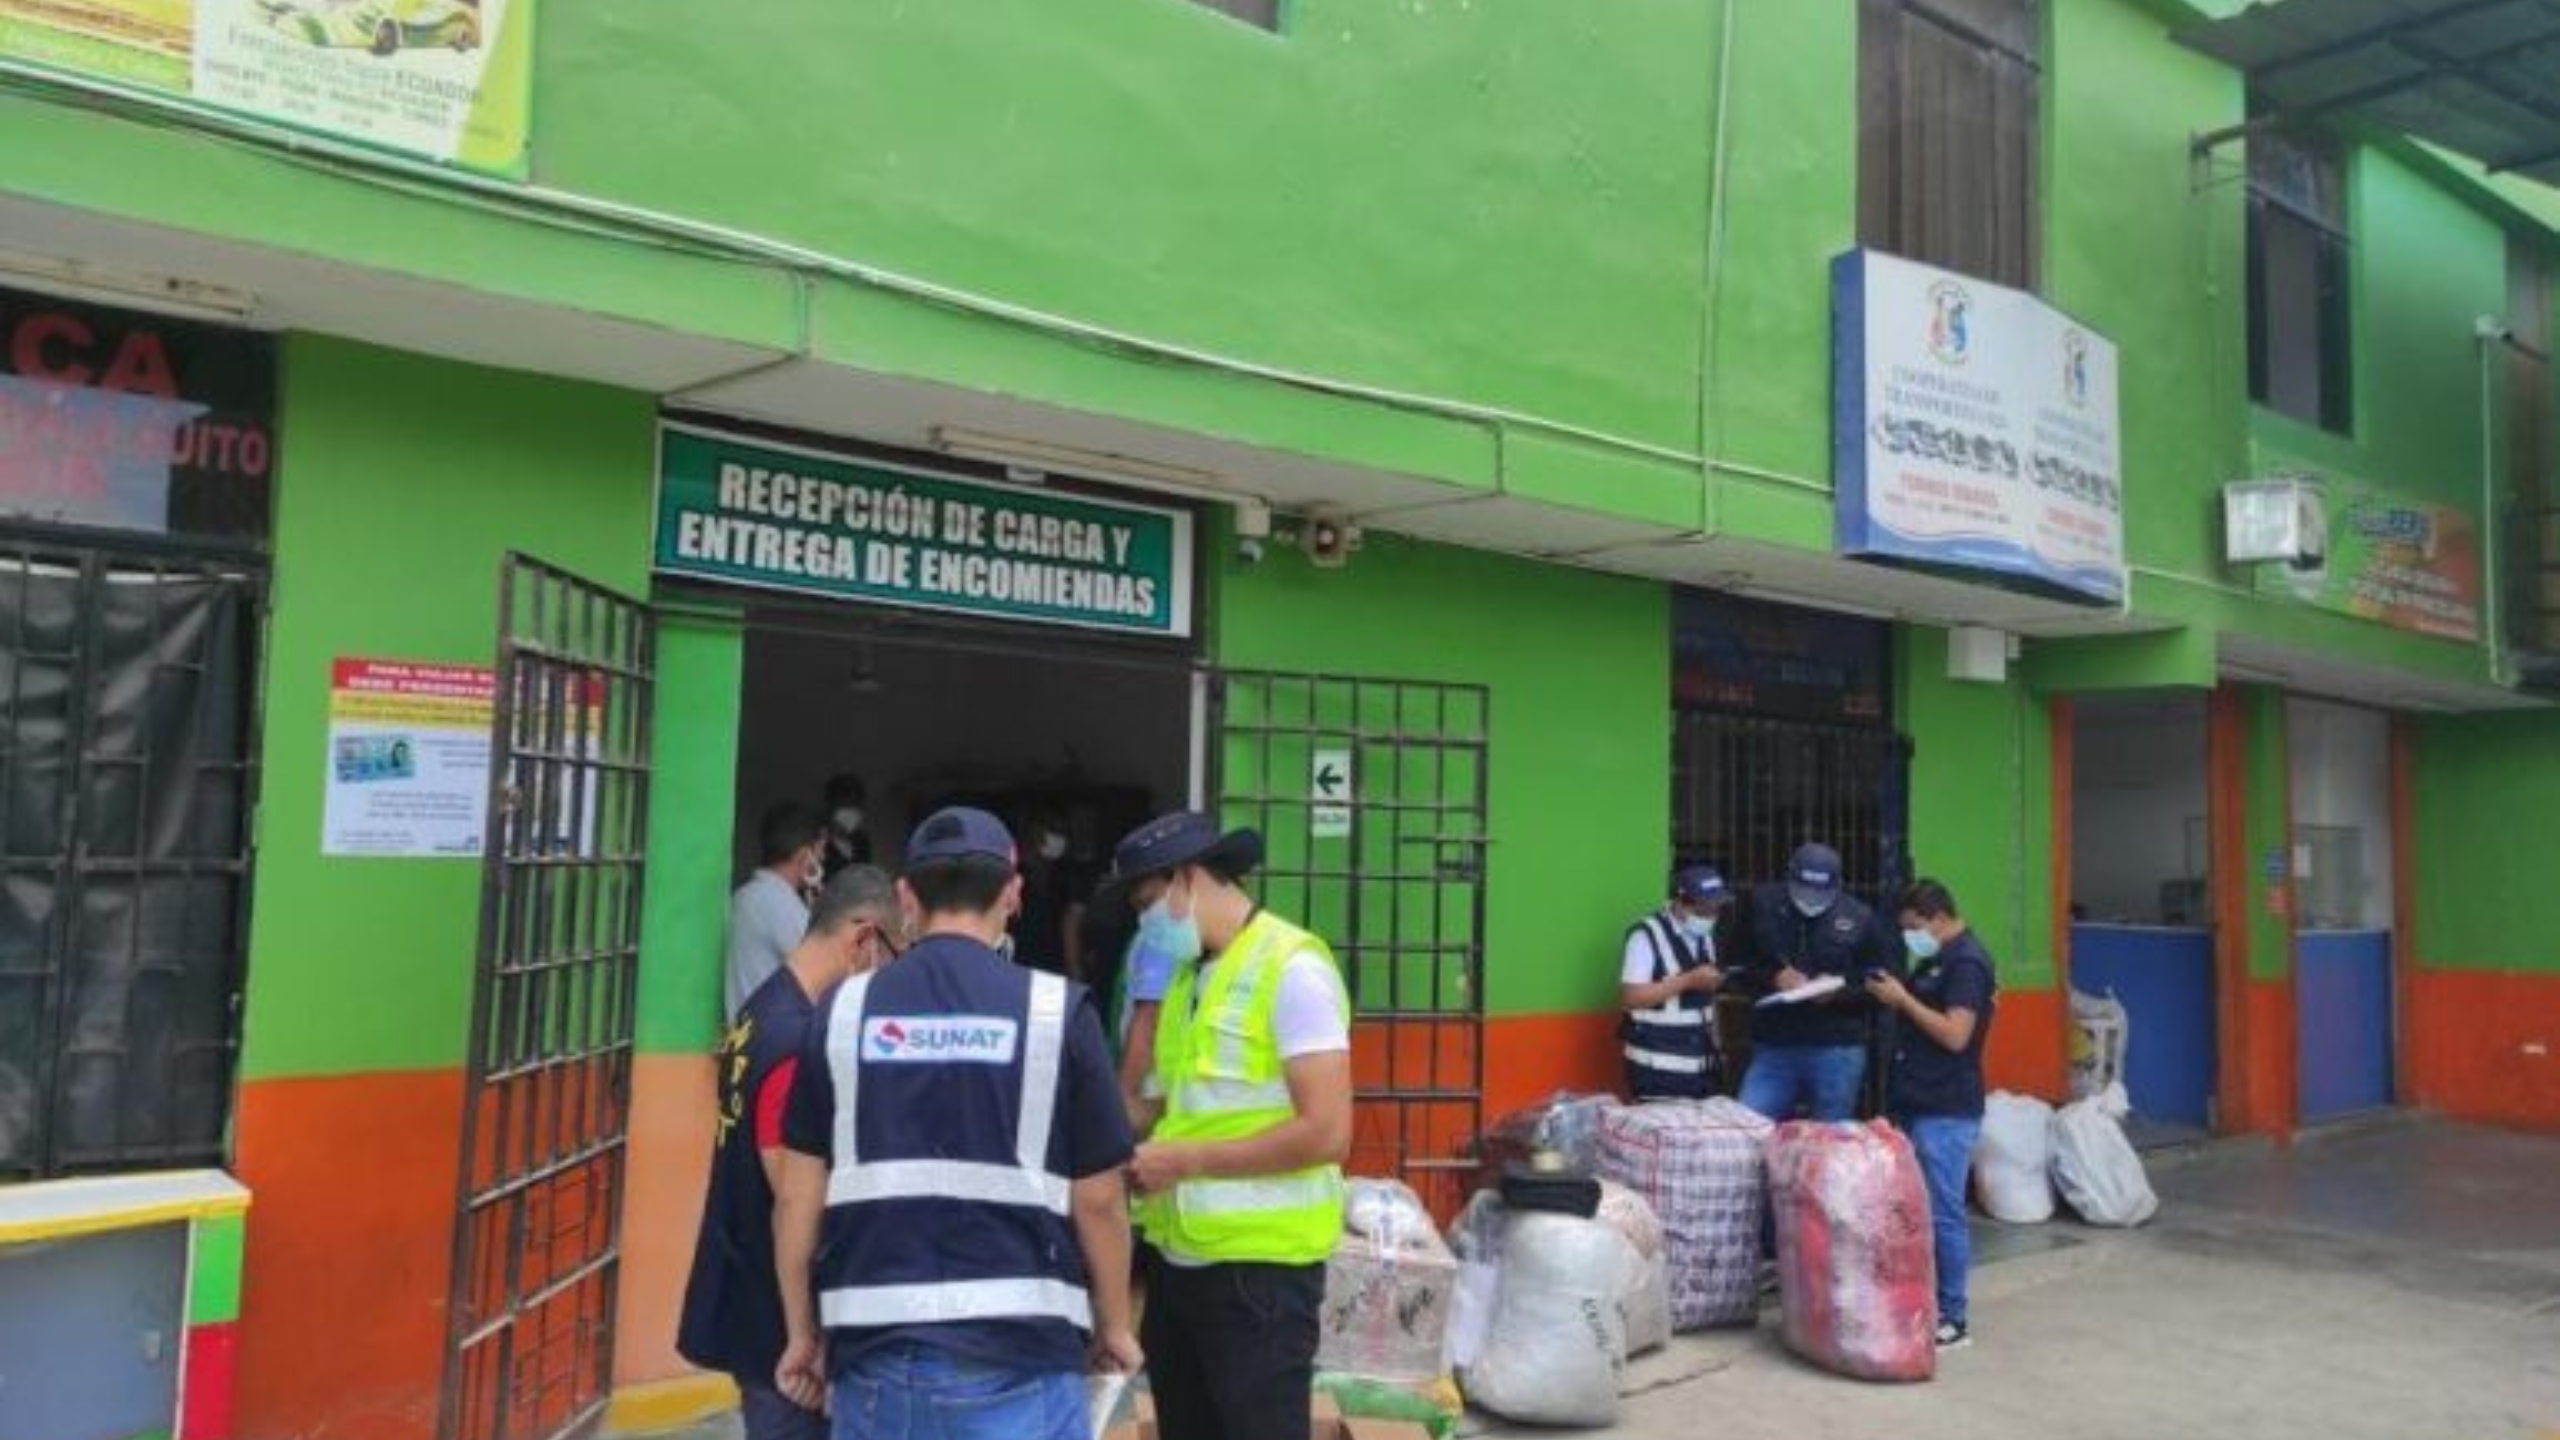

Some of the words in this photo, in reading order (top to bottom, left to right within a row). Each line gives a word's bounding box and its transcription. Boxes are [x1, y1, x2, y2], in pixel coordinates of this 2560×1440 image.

[395, 70, 483, 103] ECUADOR
[719, 463, 935, 540] RECEPCIÓN
[943, 502, 986, 548] DE
[993, 510, 1105, 564] CARGA
[1112, 526, 1132, 566] Y
[677, 511, 856, 583] ENTREGA
[864, 540, 914, 590] DE
[919, 548, 1156, 618] ENCOMIENDAS
[909, 1028, 1006, 1050] SUNAT
